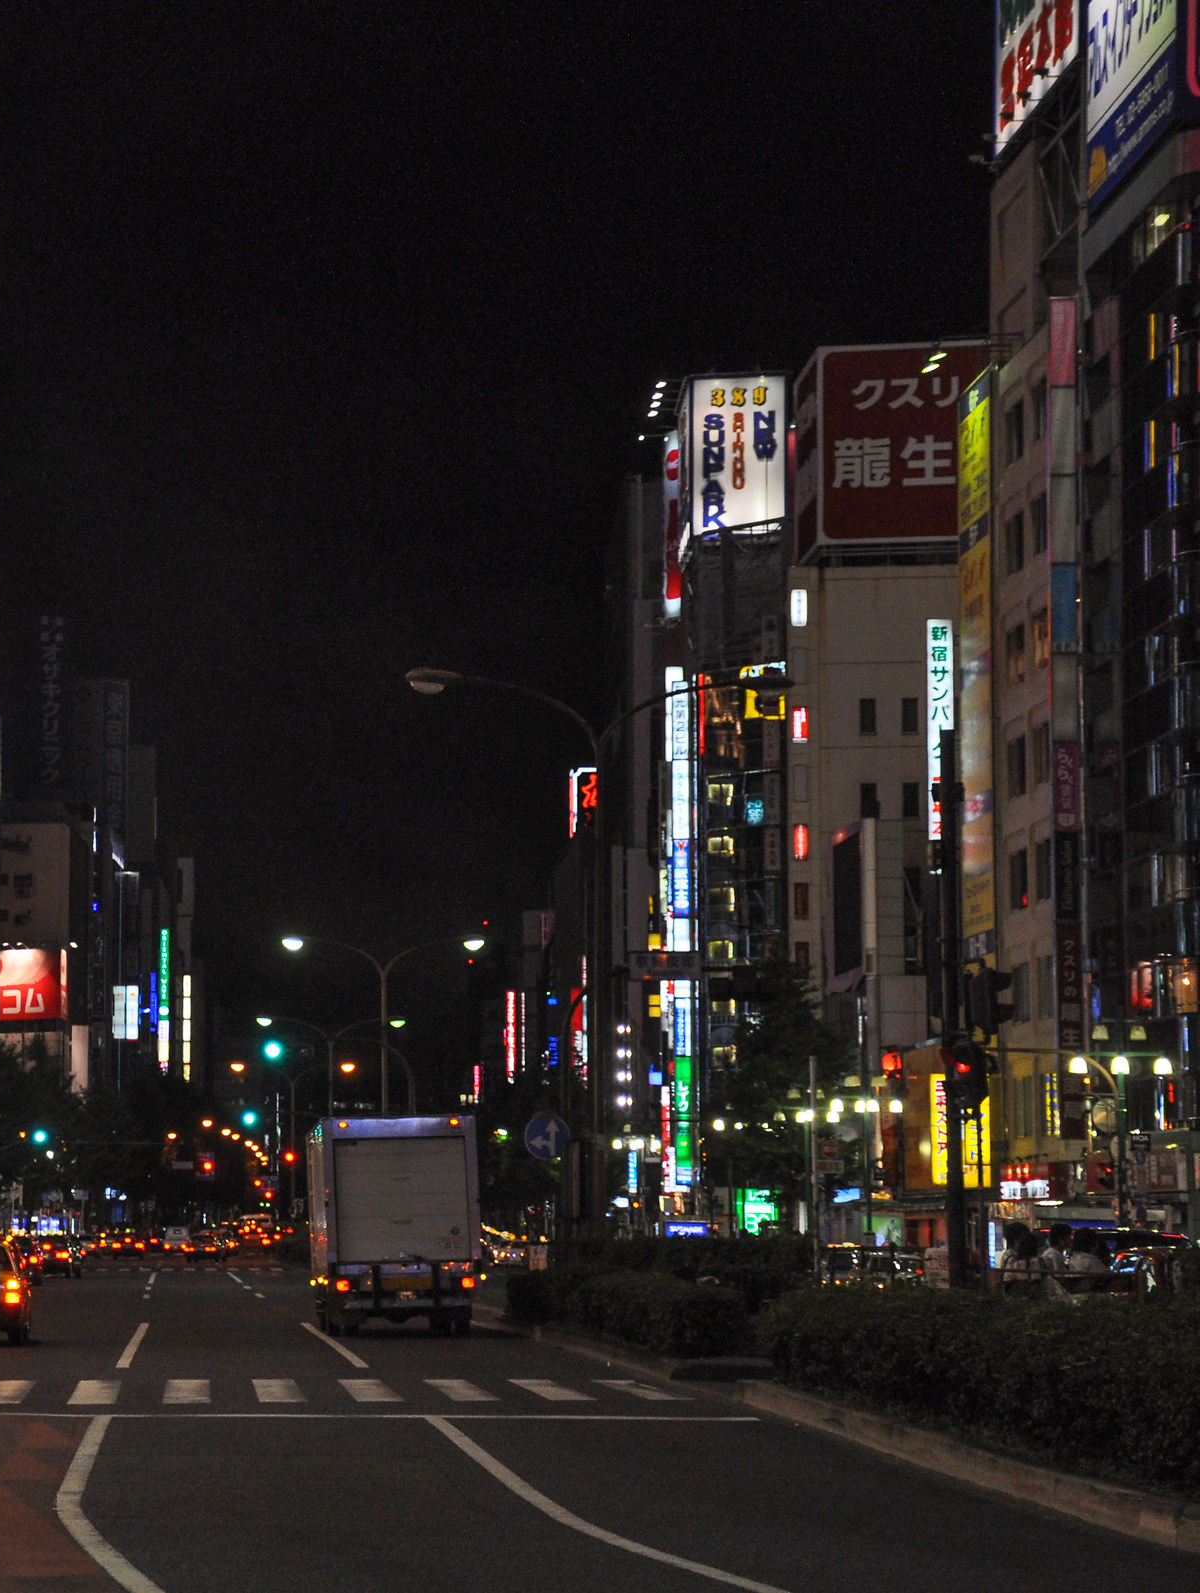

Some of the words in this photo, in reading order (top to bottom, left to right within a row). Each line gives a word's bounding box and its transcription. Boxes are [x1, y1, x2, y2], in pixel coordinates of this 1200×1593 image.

[852, 376, 960, 410] クスリ
[2, 989, 45, 1014] コム
[678, 1081, 689, 1113] レイク
